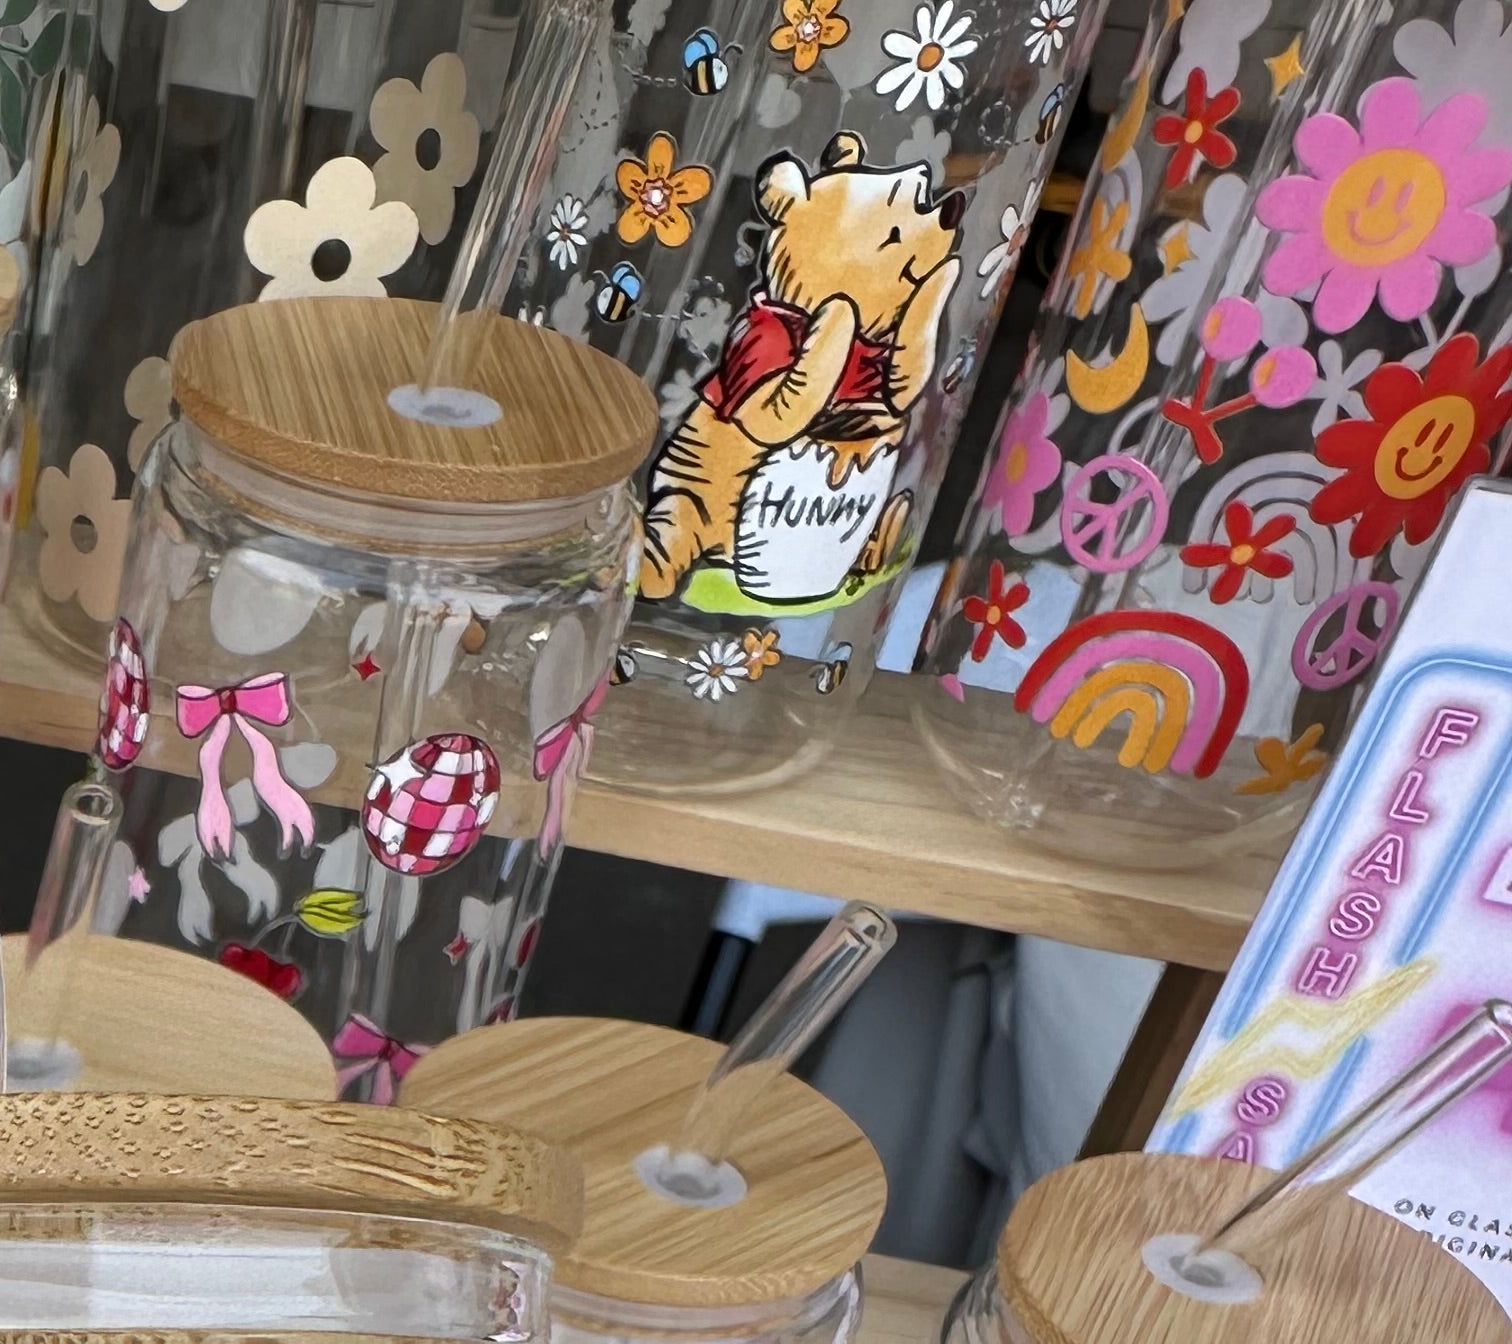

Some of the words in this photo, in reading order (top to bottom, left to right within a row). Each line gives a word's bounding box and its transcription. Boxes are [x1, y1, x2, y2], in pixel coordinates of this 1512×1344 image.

[1297, 708, 1479, 998] FLASH
[1215, 1077, 1287, 1165] SA
[1393, 1198, 1437, 1221] ON
